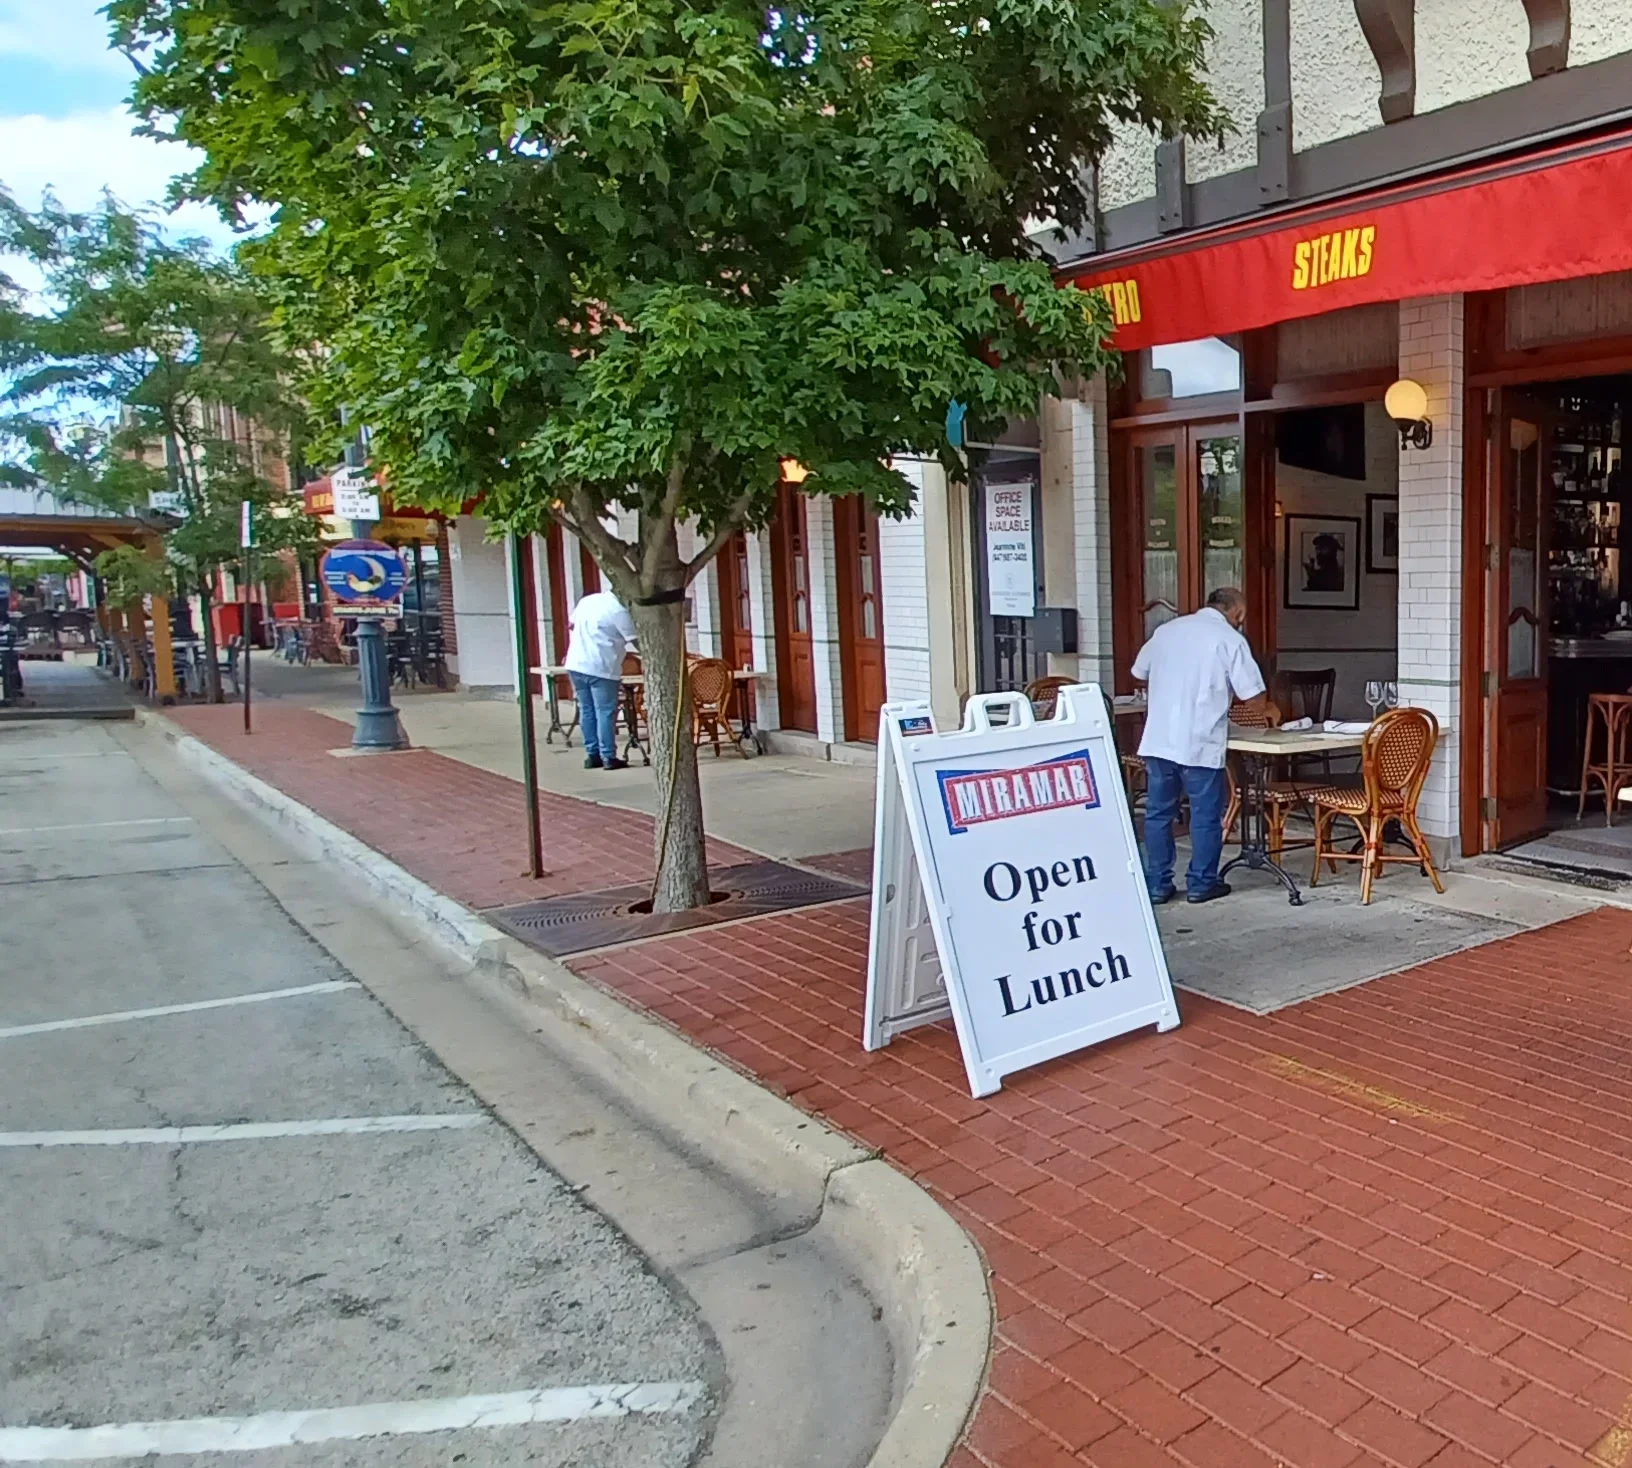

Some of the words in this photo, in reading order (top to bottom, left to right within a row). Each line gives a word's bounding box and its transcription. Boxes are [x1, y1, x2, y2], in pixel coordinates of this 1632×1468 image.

[1292, 226, 1375, 290] STEAKS
[1080, 279, 1142, 326] TRO
[336, 479, 371, 488] PARKIN
[993, 491, 1022, 504] OFFICE
[988, 519, 1030, 532] AVAILABLE
[995, 505, 1021, 518] SPACE
[953, 763, 1090, 821] MIRAMAR
[983, 854, 1099, 904] Open
[1021, 909, 1083, 952] for
[993, 945, 1132, 1018] Lunch
